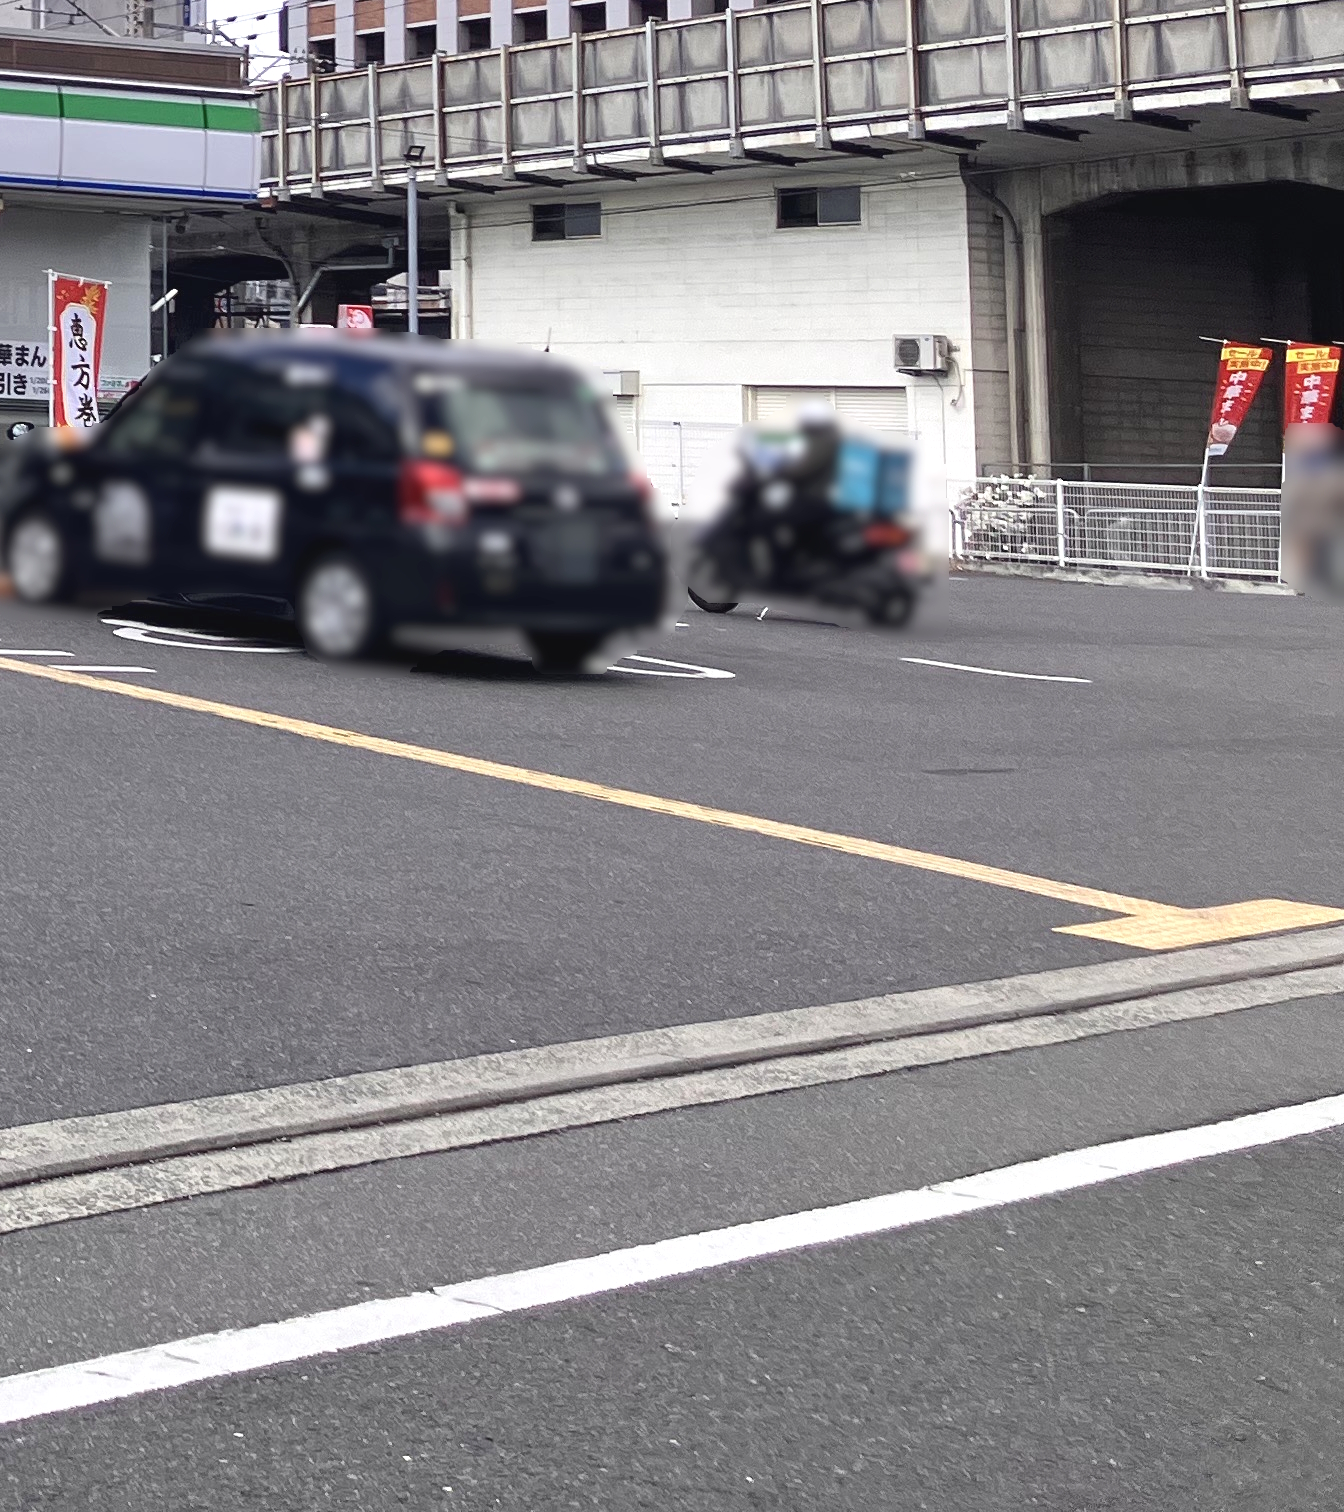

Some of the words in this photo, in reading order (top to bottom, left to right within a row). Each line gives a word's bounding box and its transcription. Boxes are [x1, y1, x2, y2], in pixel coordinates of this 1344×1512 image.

[69, 312, 97, 427] 恵方巻
[1299, 374, 1322, 423] 中華ま
